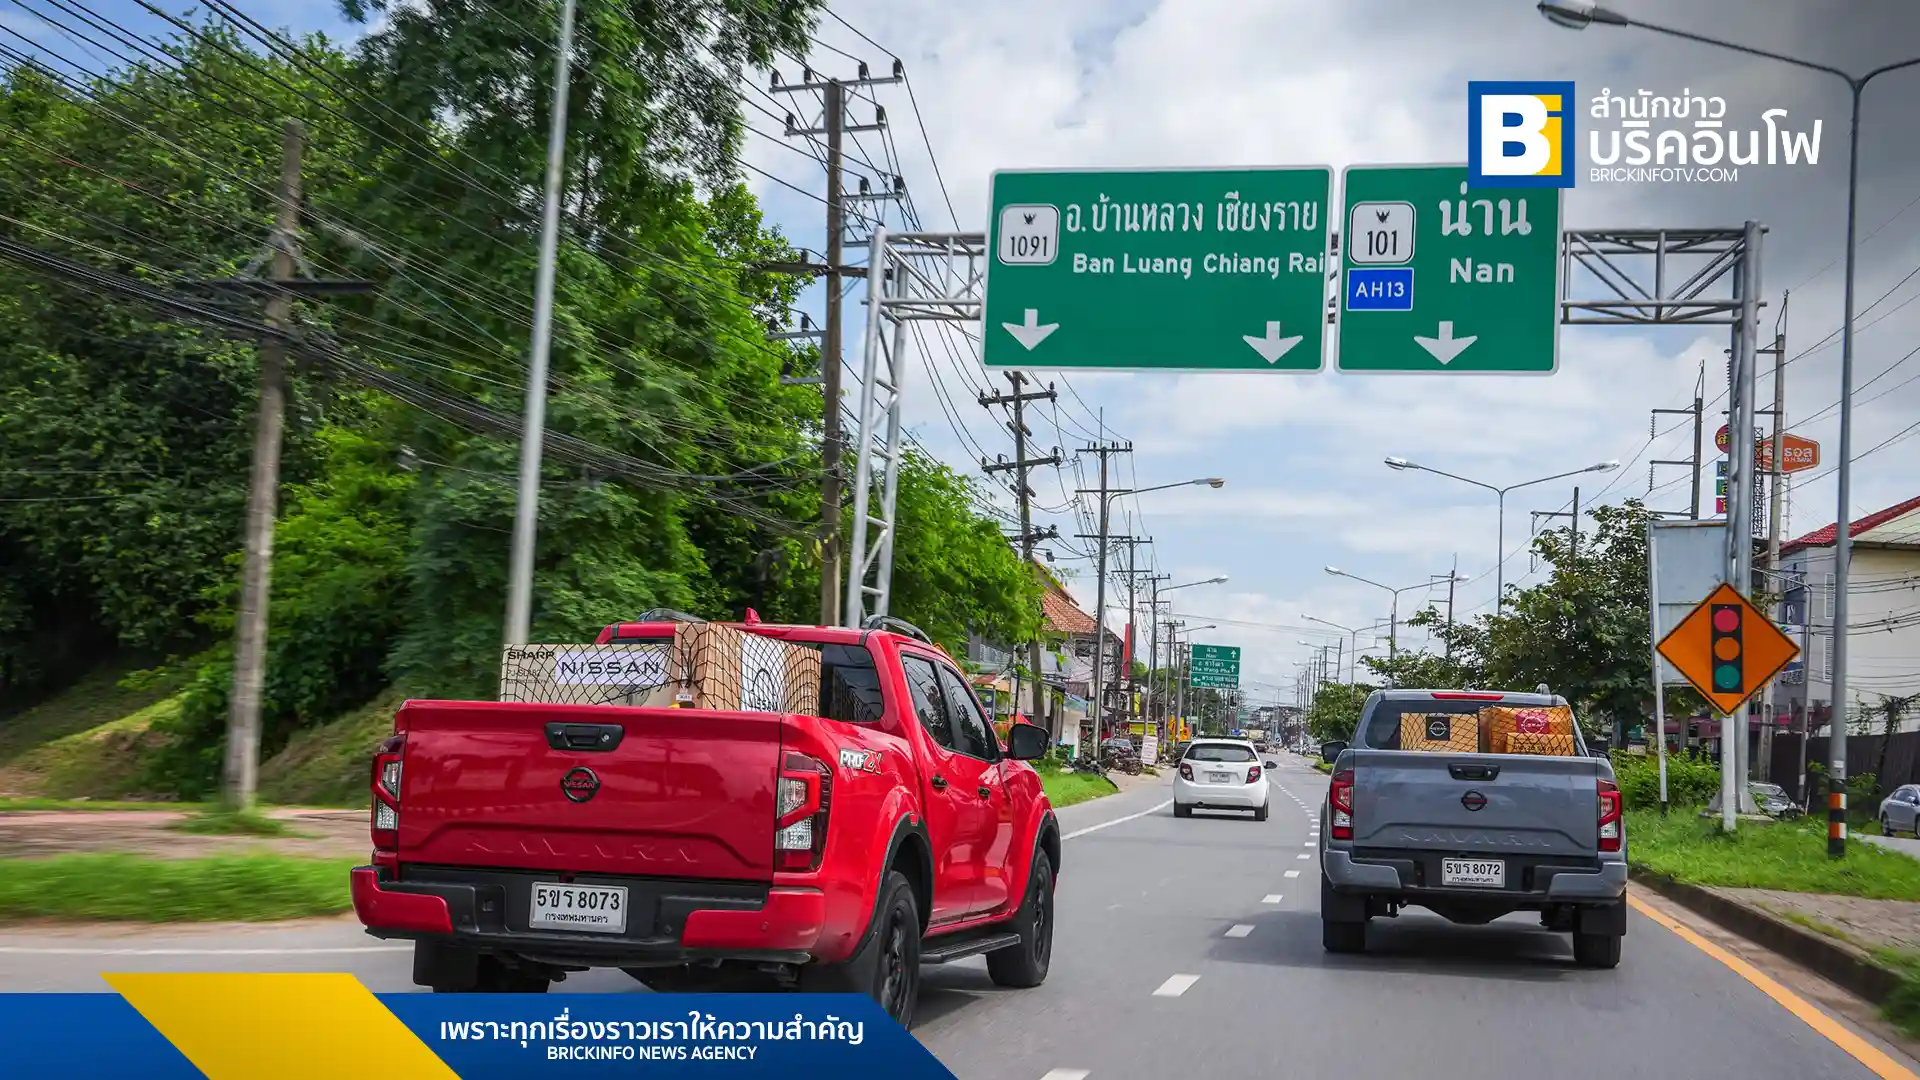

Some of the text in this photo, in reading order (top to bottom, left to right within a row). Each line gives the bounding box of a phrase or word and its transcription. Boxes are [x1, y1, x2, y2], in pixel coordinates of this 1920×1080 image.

[1066, 191, 1319, 234] อ.บ้านหลวง เชียงราย
[1438, 181, 1533, 238] น่าน
[1008, 235, 1049, 259] 1091
[1365, 229, 1398, 257] 101
[1073, 252, 1325, 280] Ban Luang Chiang Rai
[1449, 257, 1516, 284] Nan
[1355, 279, 1405, 300] AH13
[508, 651, 555, 660] SHARP
[561, 661, 660, 676] NISSAN
[1473, 864, 1501, 875] 8072
[577, 891, 620, 911] 8073
[544, 911, 609, 924] กรุงเทพมหานคร
